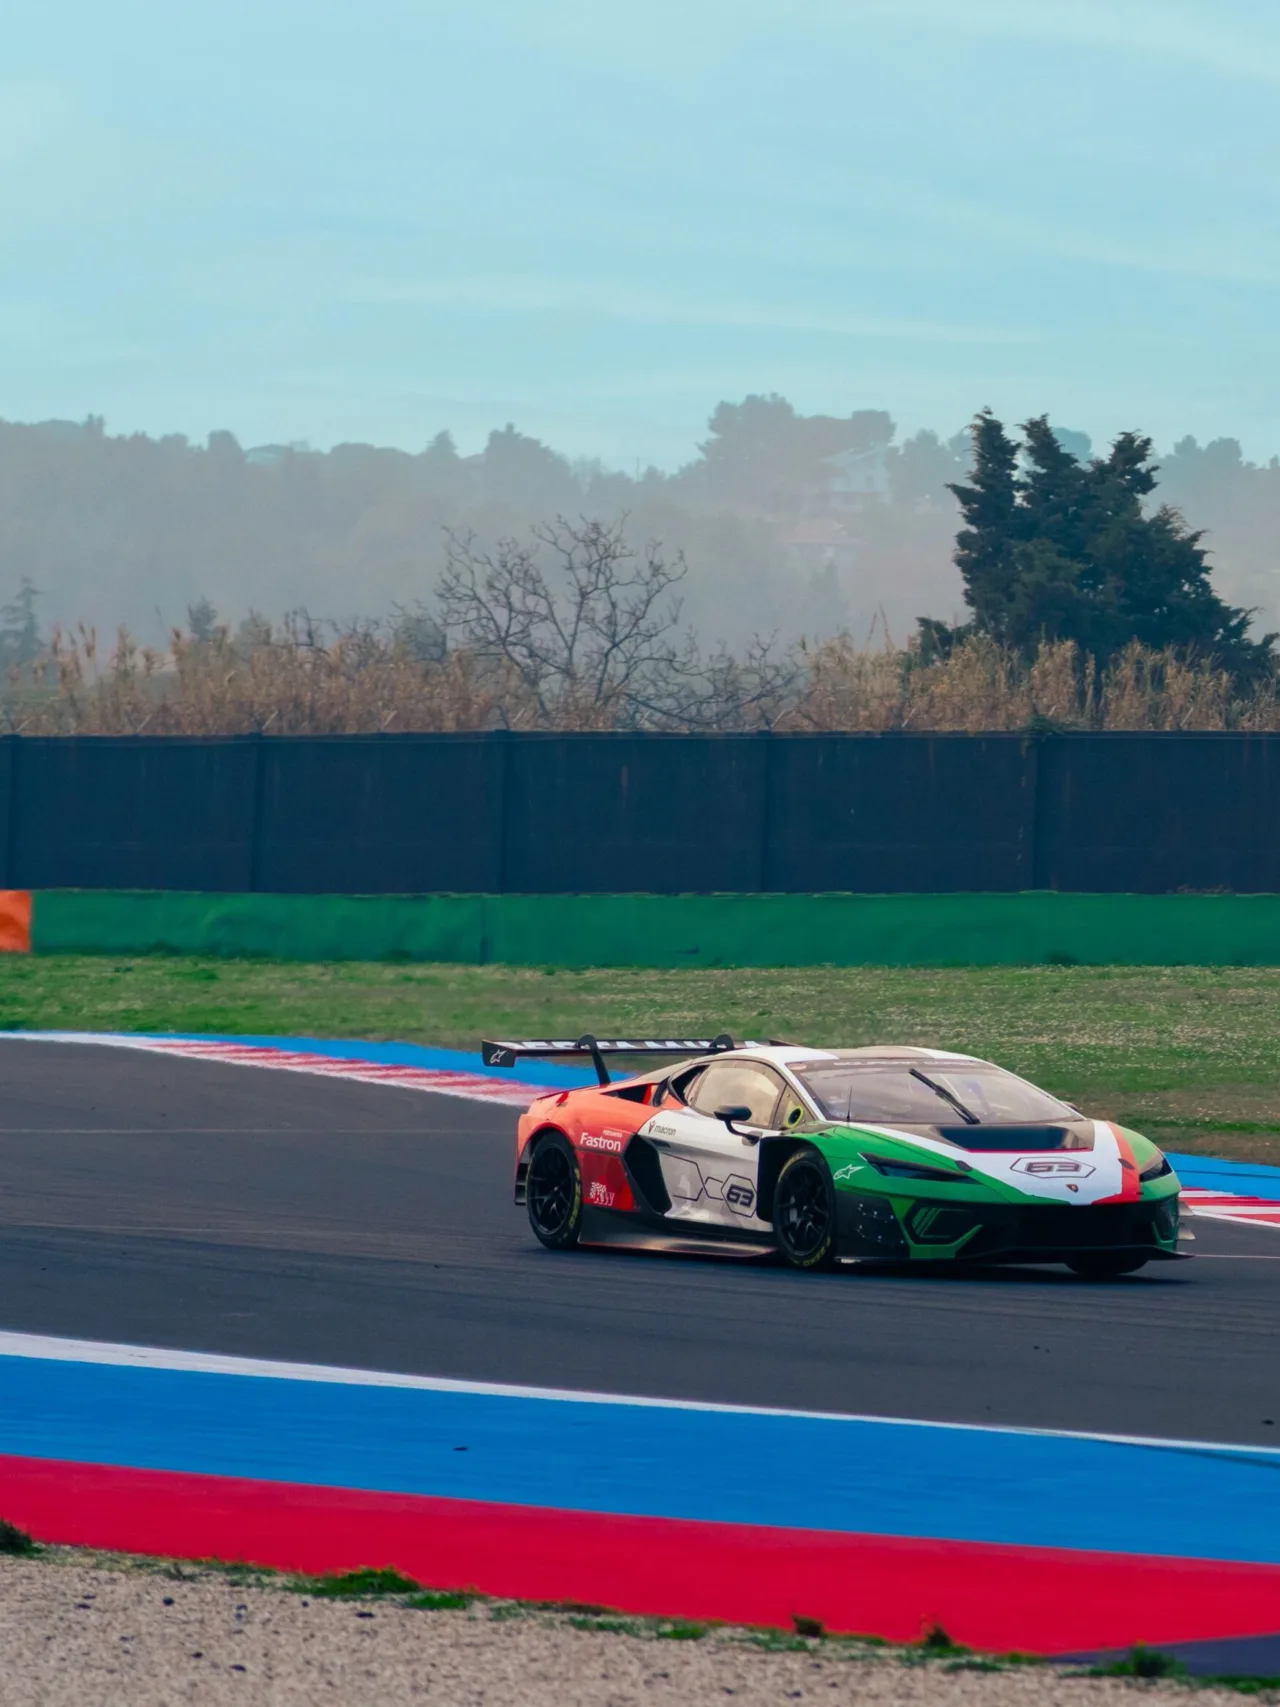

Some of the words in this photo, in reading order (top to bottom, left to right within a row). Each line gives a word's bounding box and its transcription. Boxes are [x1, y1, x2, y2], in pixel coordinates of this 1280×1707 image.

[654, 1124, 677, 1136] macron
[580, 1132, 621, 1152] Fastron
[1025, 1162, 1081, 1173] 63
[726, 1184, 755, 1208] 63
